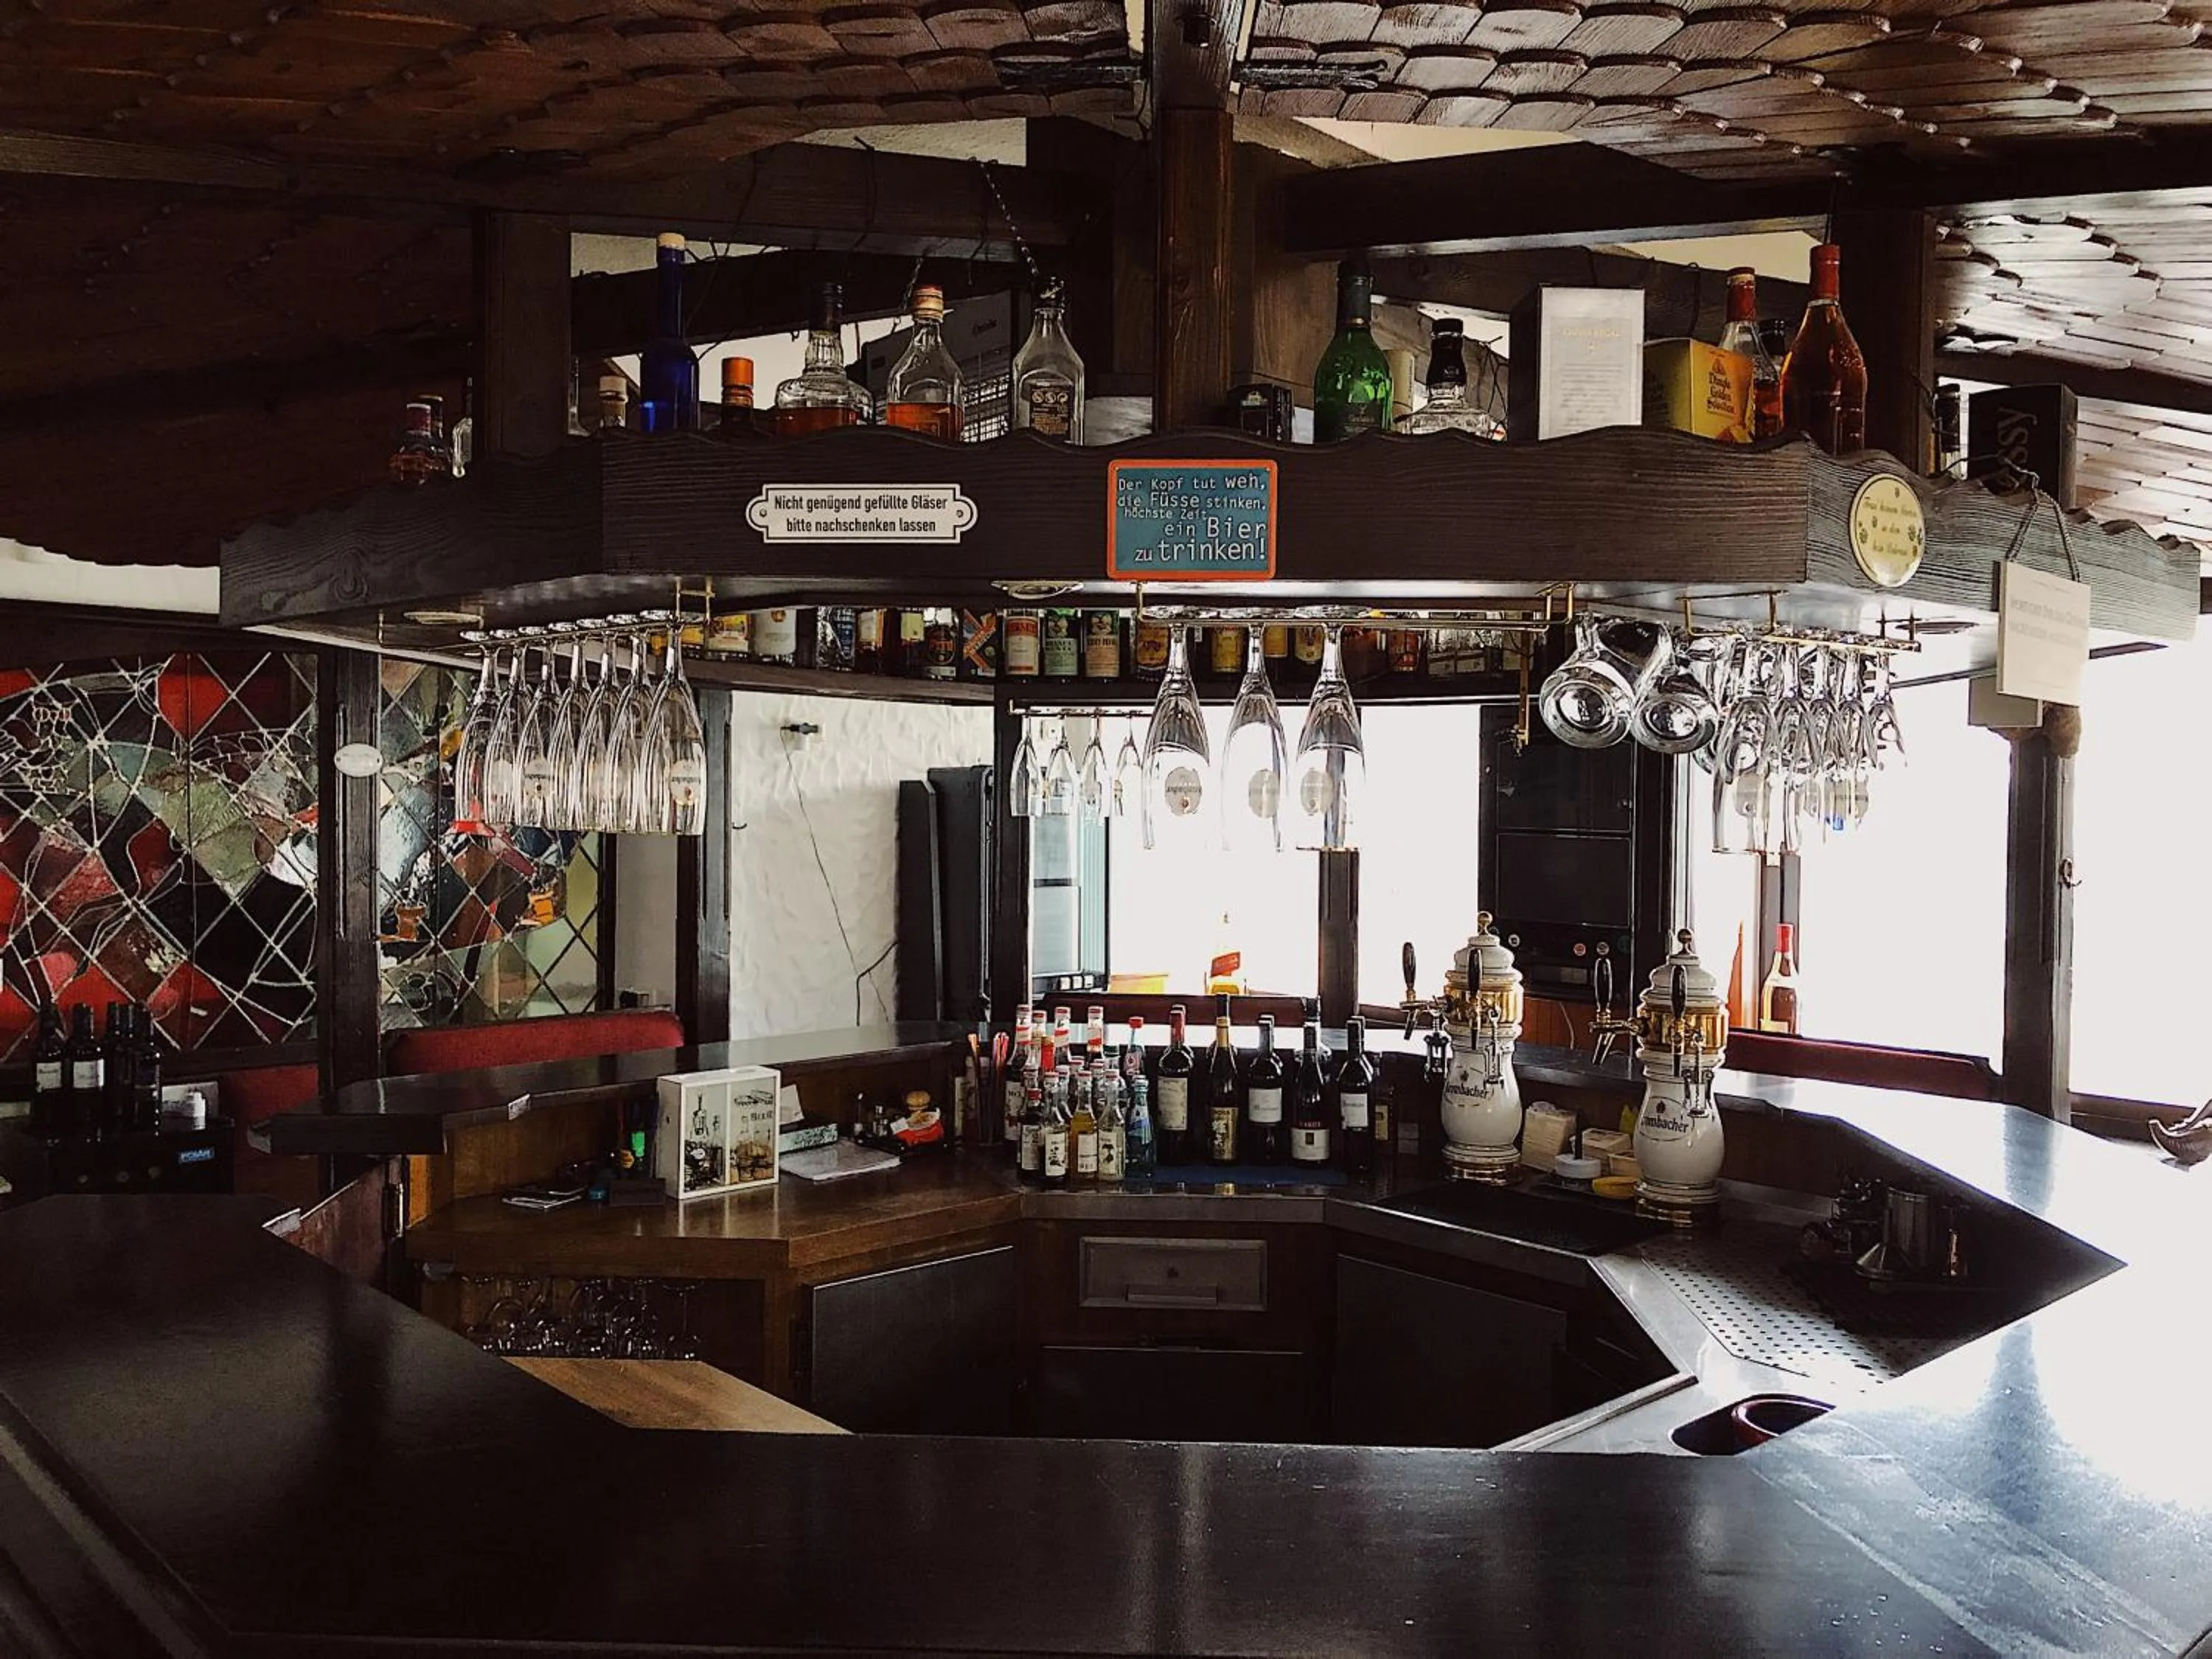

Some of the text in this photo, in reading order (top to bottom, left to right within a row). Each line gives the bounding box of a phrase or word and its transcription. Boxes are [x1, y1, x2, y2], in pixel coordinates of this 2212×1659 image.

[1119, 473, 1266, 495] Der Kopf tut weh,
[774, 495, 947, 512] Nicht genügend gefüllte Gläser
[1117, 495, 1141, 507] die
[1150, 492, 1200, 508] Füsse
[1124, 507, 1172, 518] höchste
[787, 518, 936, 532] bitte nachschenken lassen
[1164, 517, 1266, 539] ein Bier
[1135, 538, 1266, 561] zu trinken!
